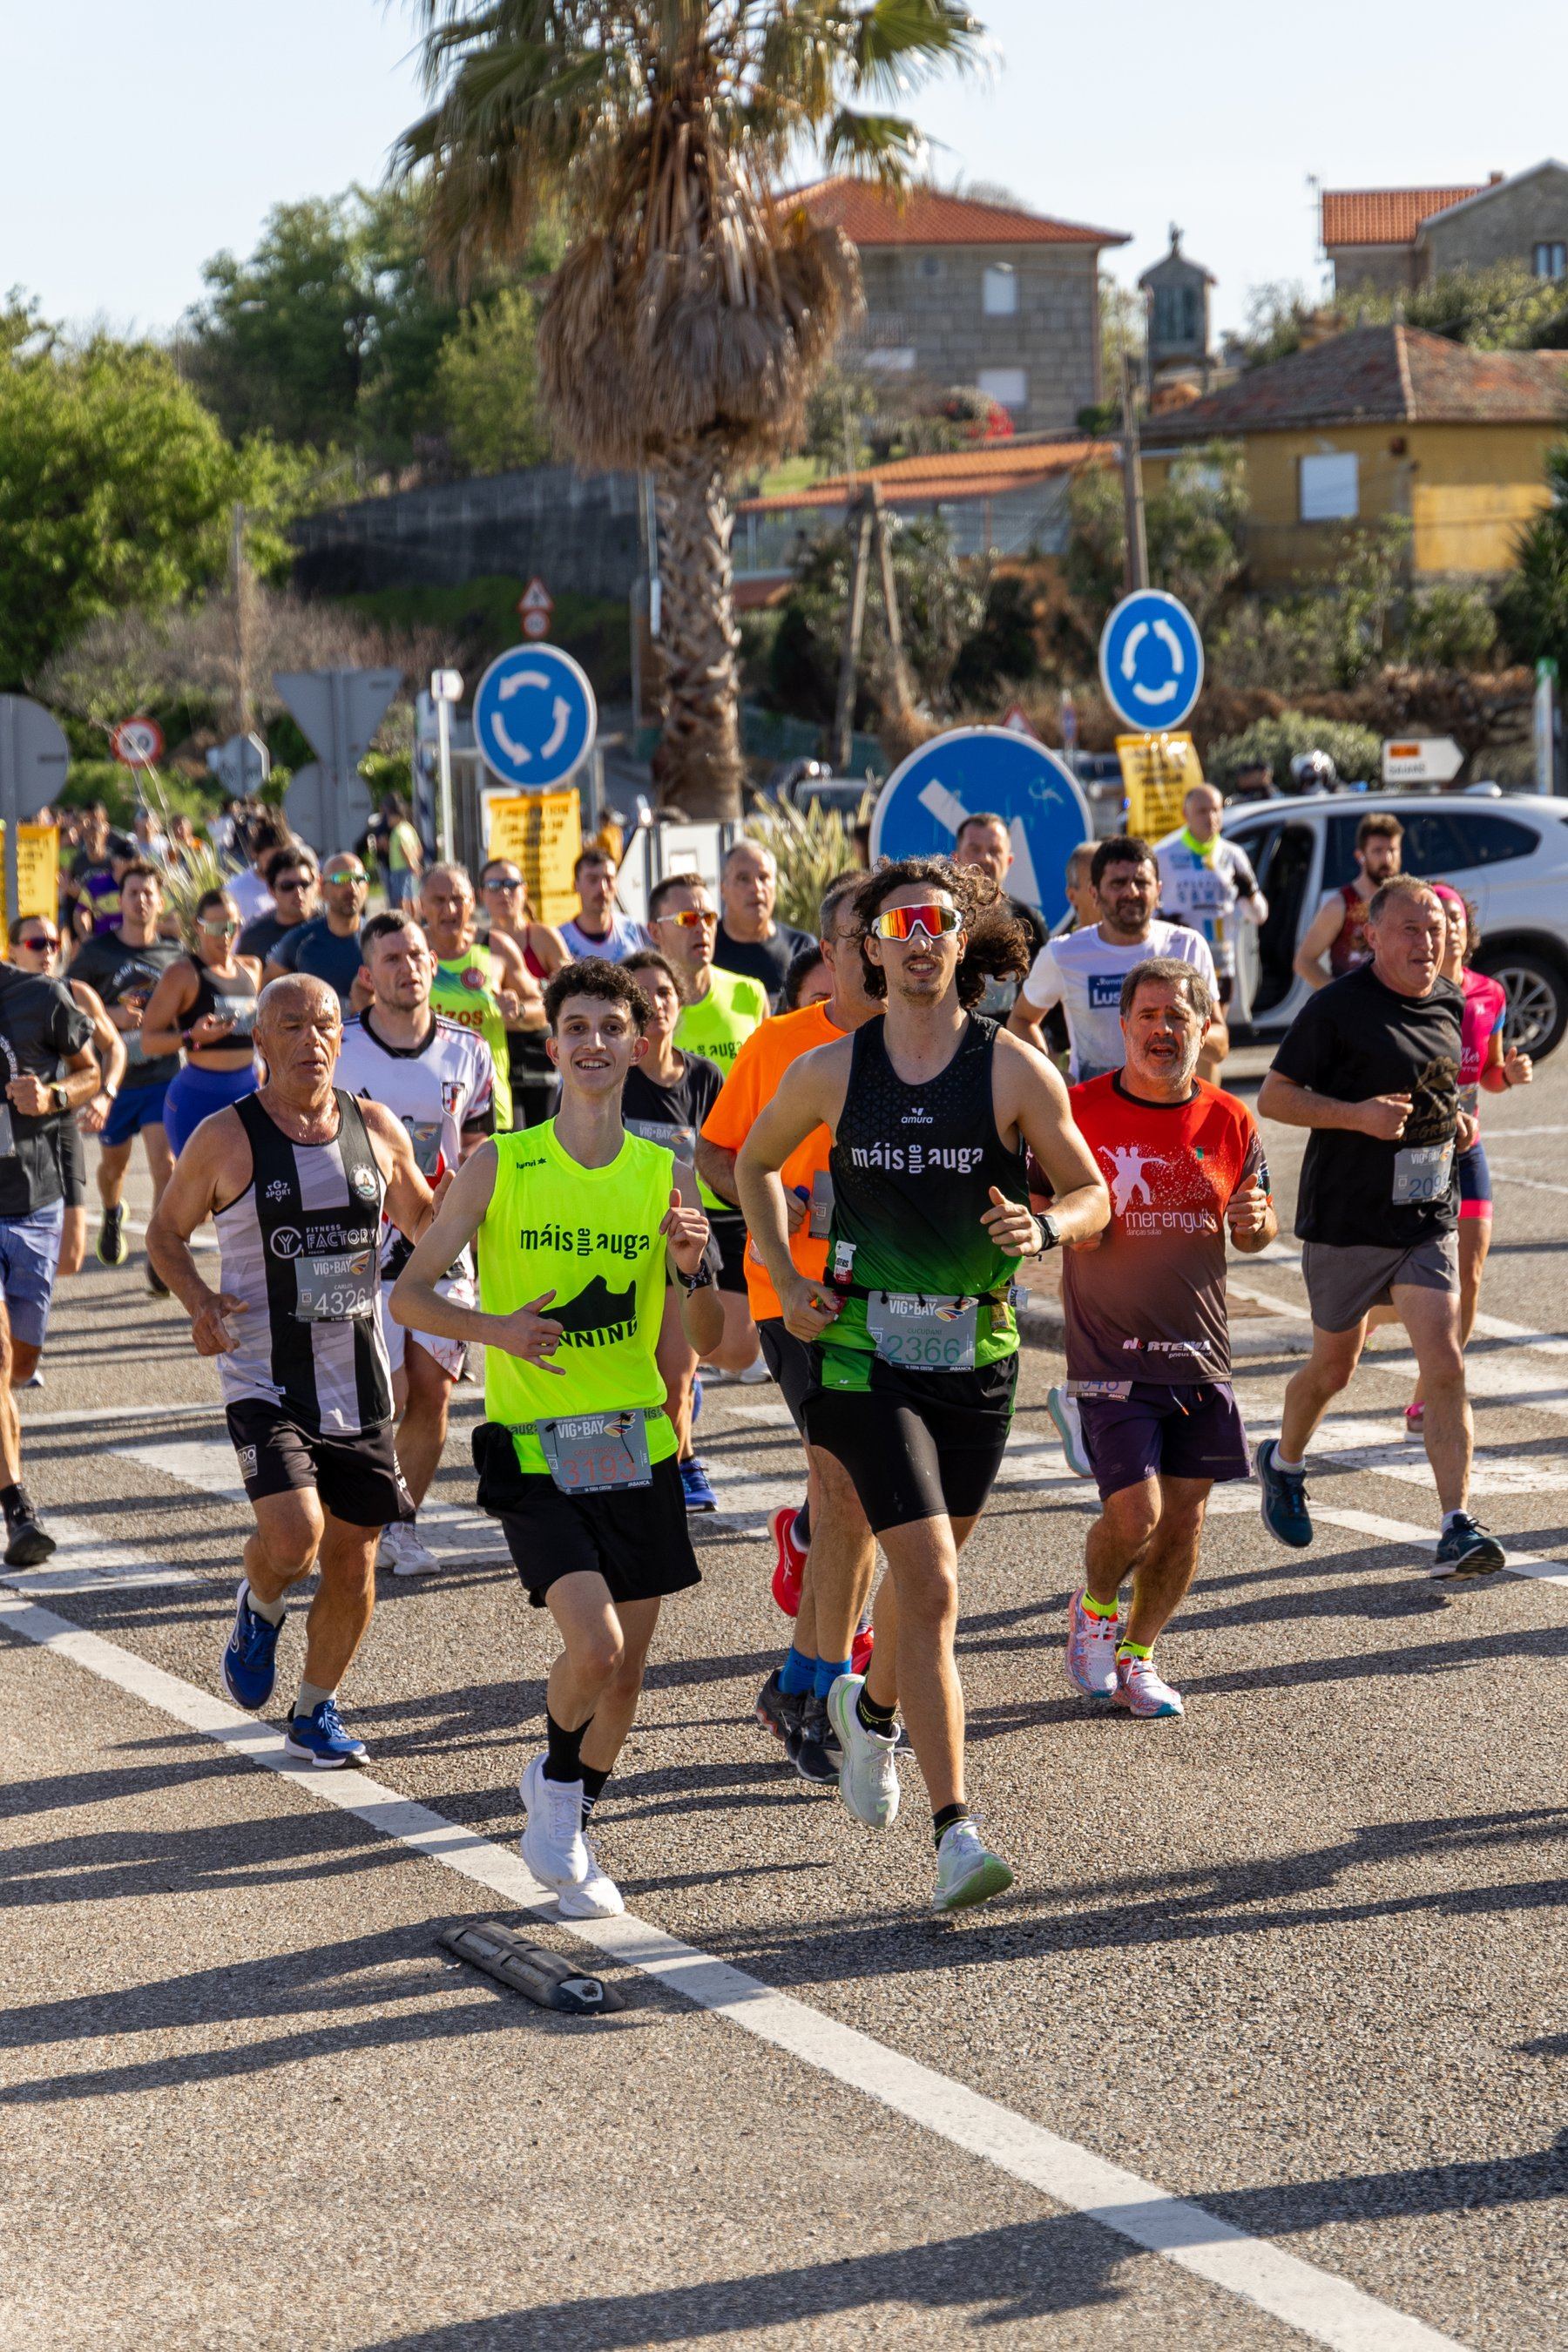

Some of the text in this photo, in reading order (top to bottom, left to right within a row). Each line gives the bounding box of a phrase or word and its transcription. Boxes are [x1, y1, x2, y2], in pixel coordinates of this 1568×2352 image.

[639, 1126, 671, 1139] VIG BAY
[851, 1142, 983, 1173] máis que auga
[266, 1187, 291, 1199] SPORT
[306, 1224, 341, 1233] FITNESS
[308, 1228, 375, 1249] FACTORY
[520, 1224, 650, 1260] máis que auga
[314, 1260, 352, 1276] VIG BAY
[314, 1288, 366, 1315] 4326
[889, 1300, 936, 1315] VIG BAY
[888, 1335, 960, 1363] 2366
[558, 1420, 605, 1438] VIG BAY
[562, 1452, 636, 1485] 3193
